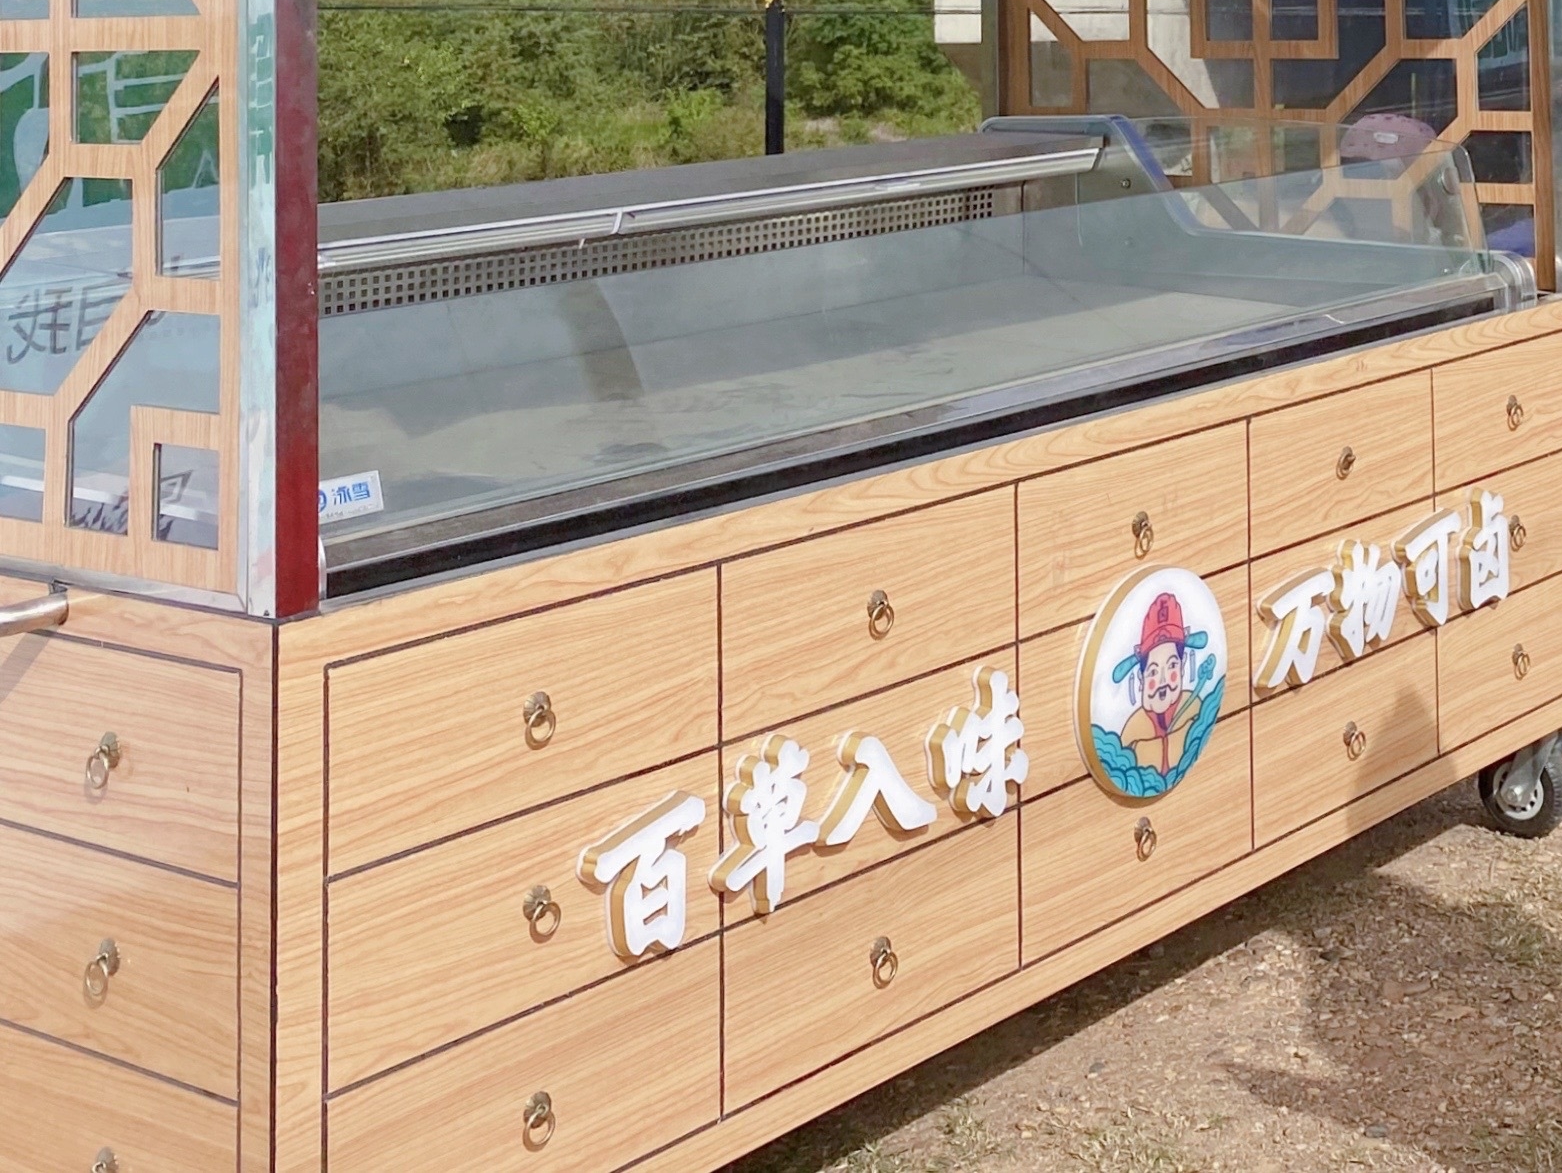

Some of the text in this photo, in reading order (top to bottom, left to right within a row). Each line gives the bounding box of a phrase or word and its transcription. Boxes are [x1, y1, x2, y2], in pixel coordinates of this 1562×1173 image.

[1252, 487, 1510, 695] 万物可卤
[577, 665, 1029, 959] 百草入味
